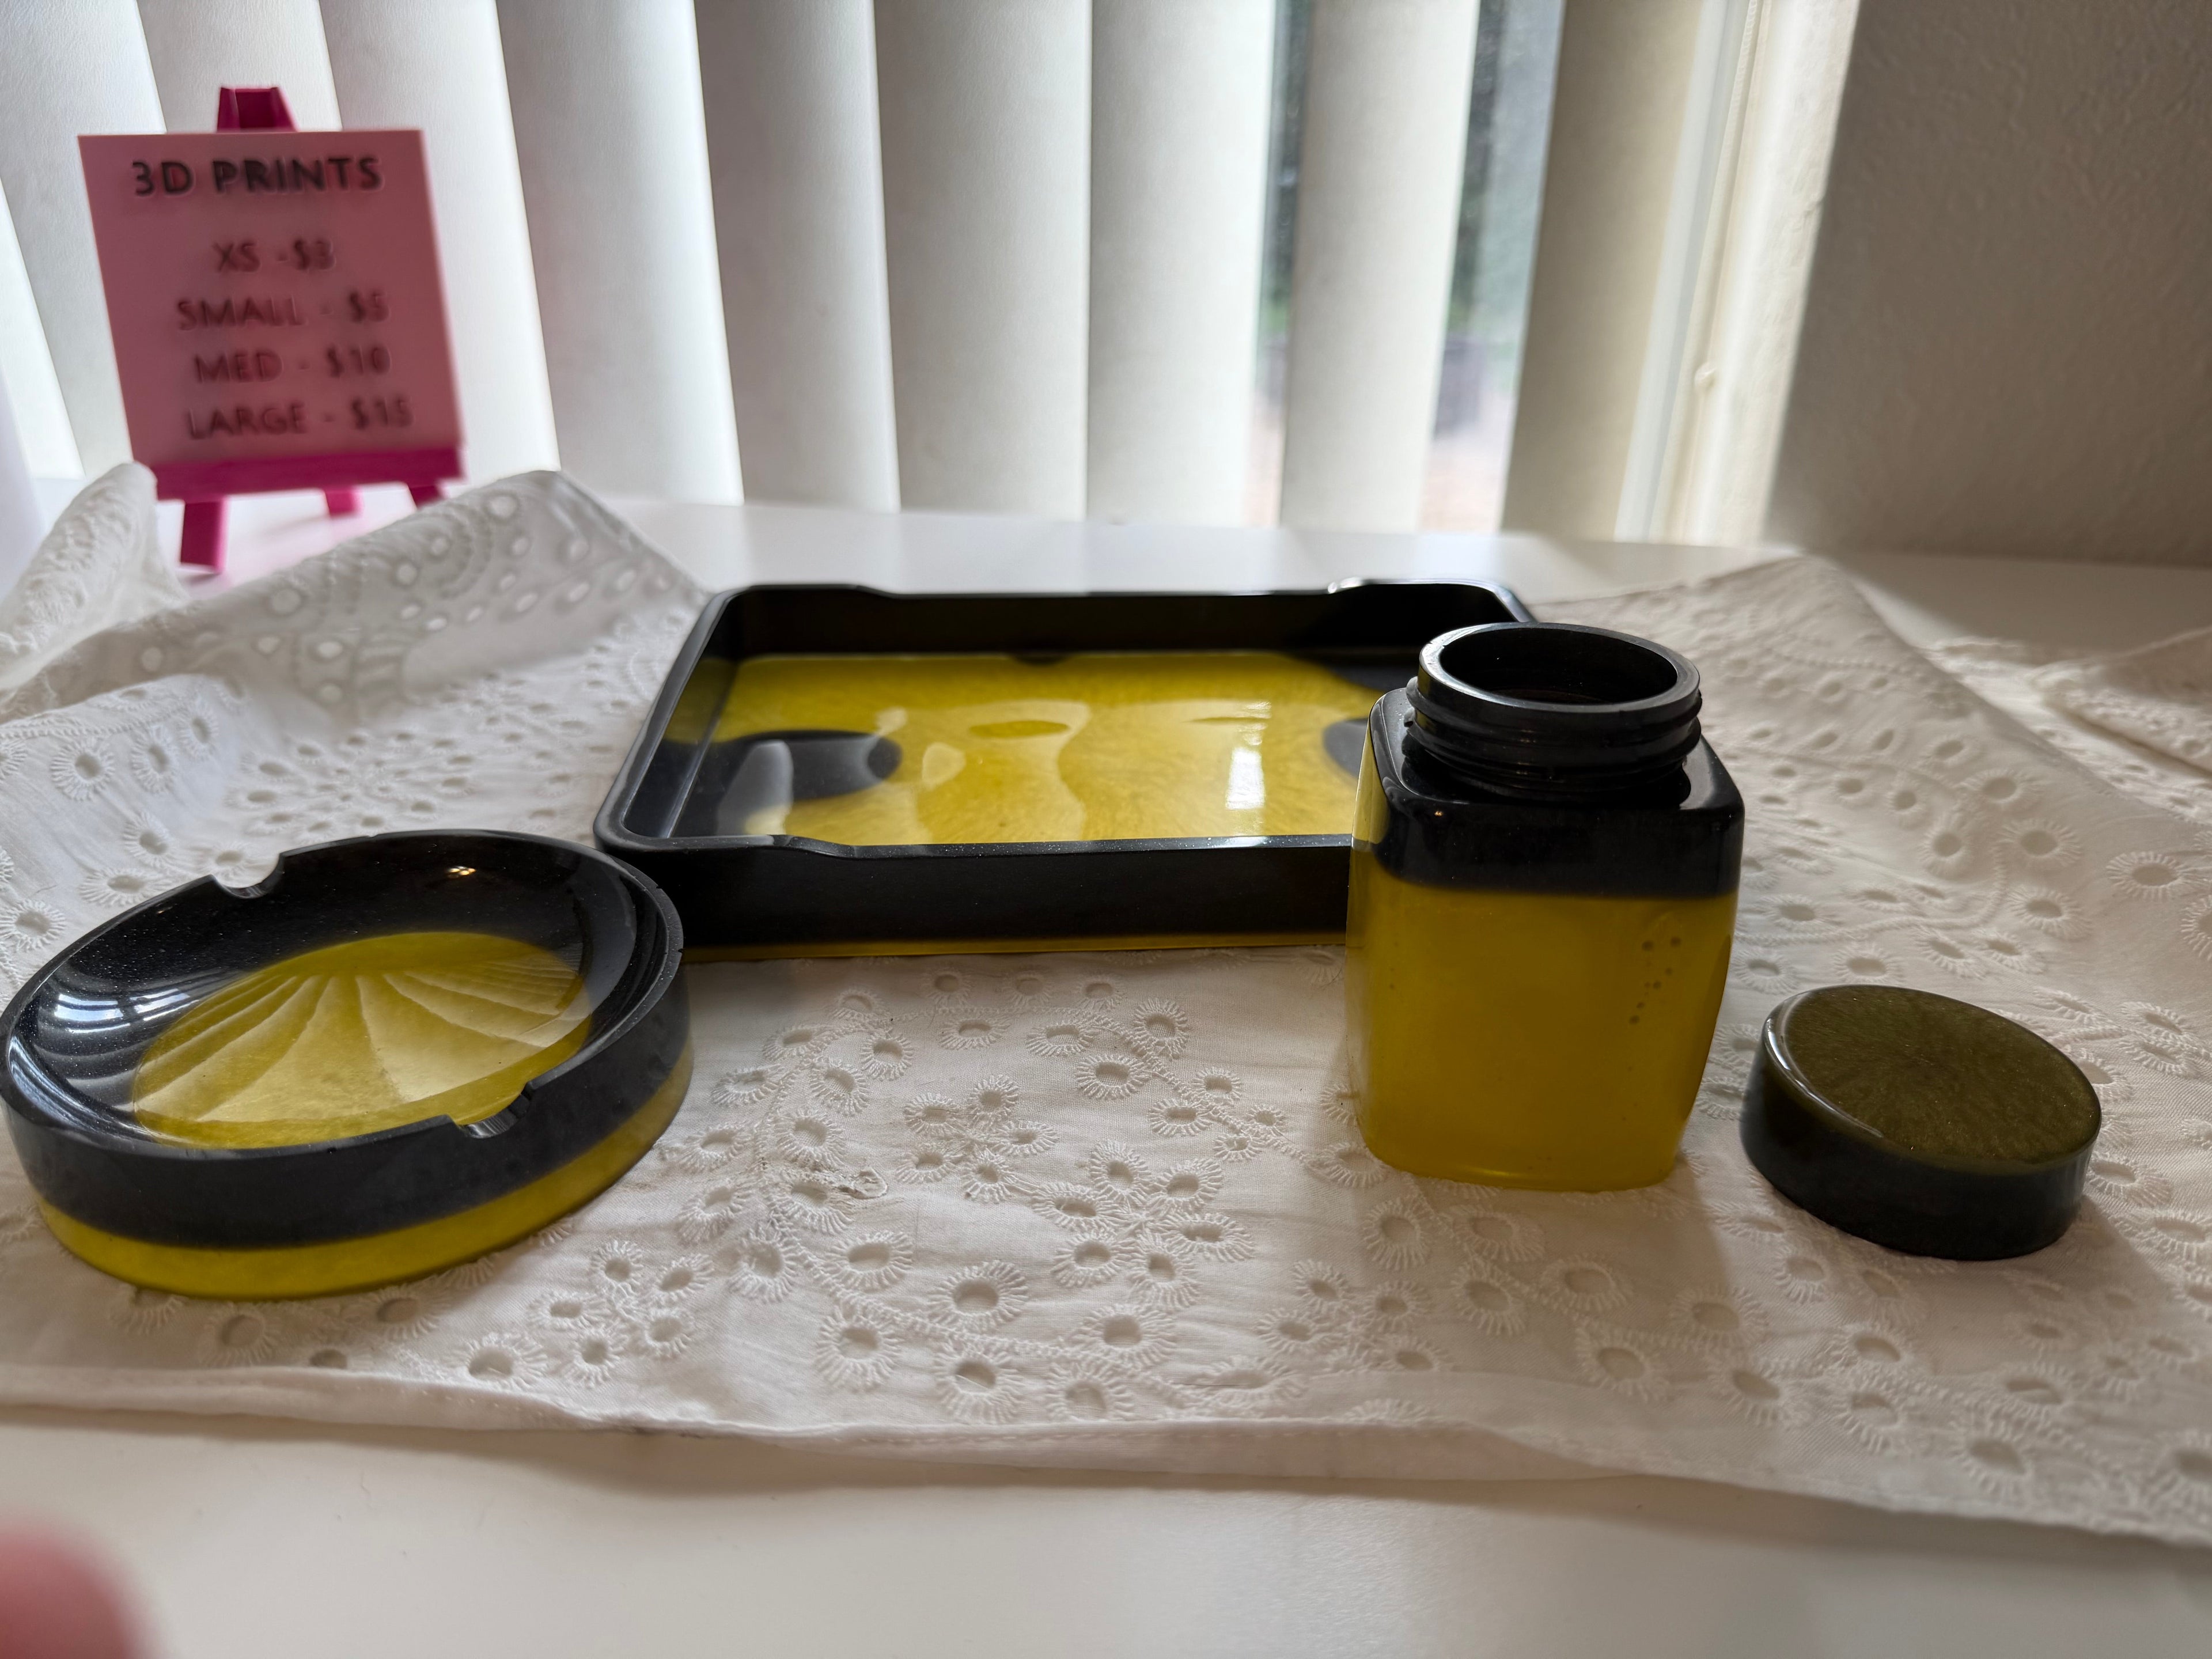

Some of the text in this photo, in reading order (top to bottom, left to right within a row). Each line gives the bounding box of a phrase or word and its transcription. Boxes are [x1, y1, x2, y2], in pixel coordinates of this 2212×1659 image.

[132, 155, 384, 196] 3D PRINTS
[212, 241, 260, 272] XS
[177, 295, 308, 330] SMALL
[349, 290, 391, 324] $5
[194, 349, 283, 383] MED
[327, 346, 391, 378] $10
[187, 401, 308, 440] LARGE
[351, 398, 414, 430] $15
